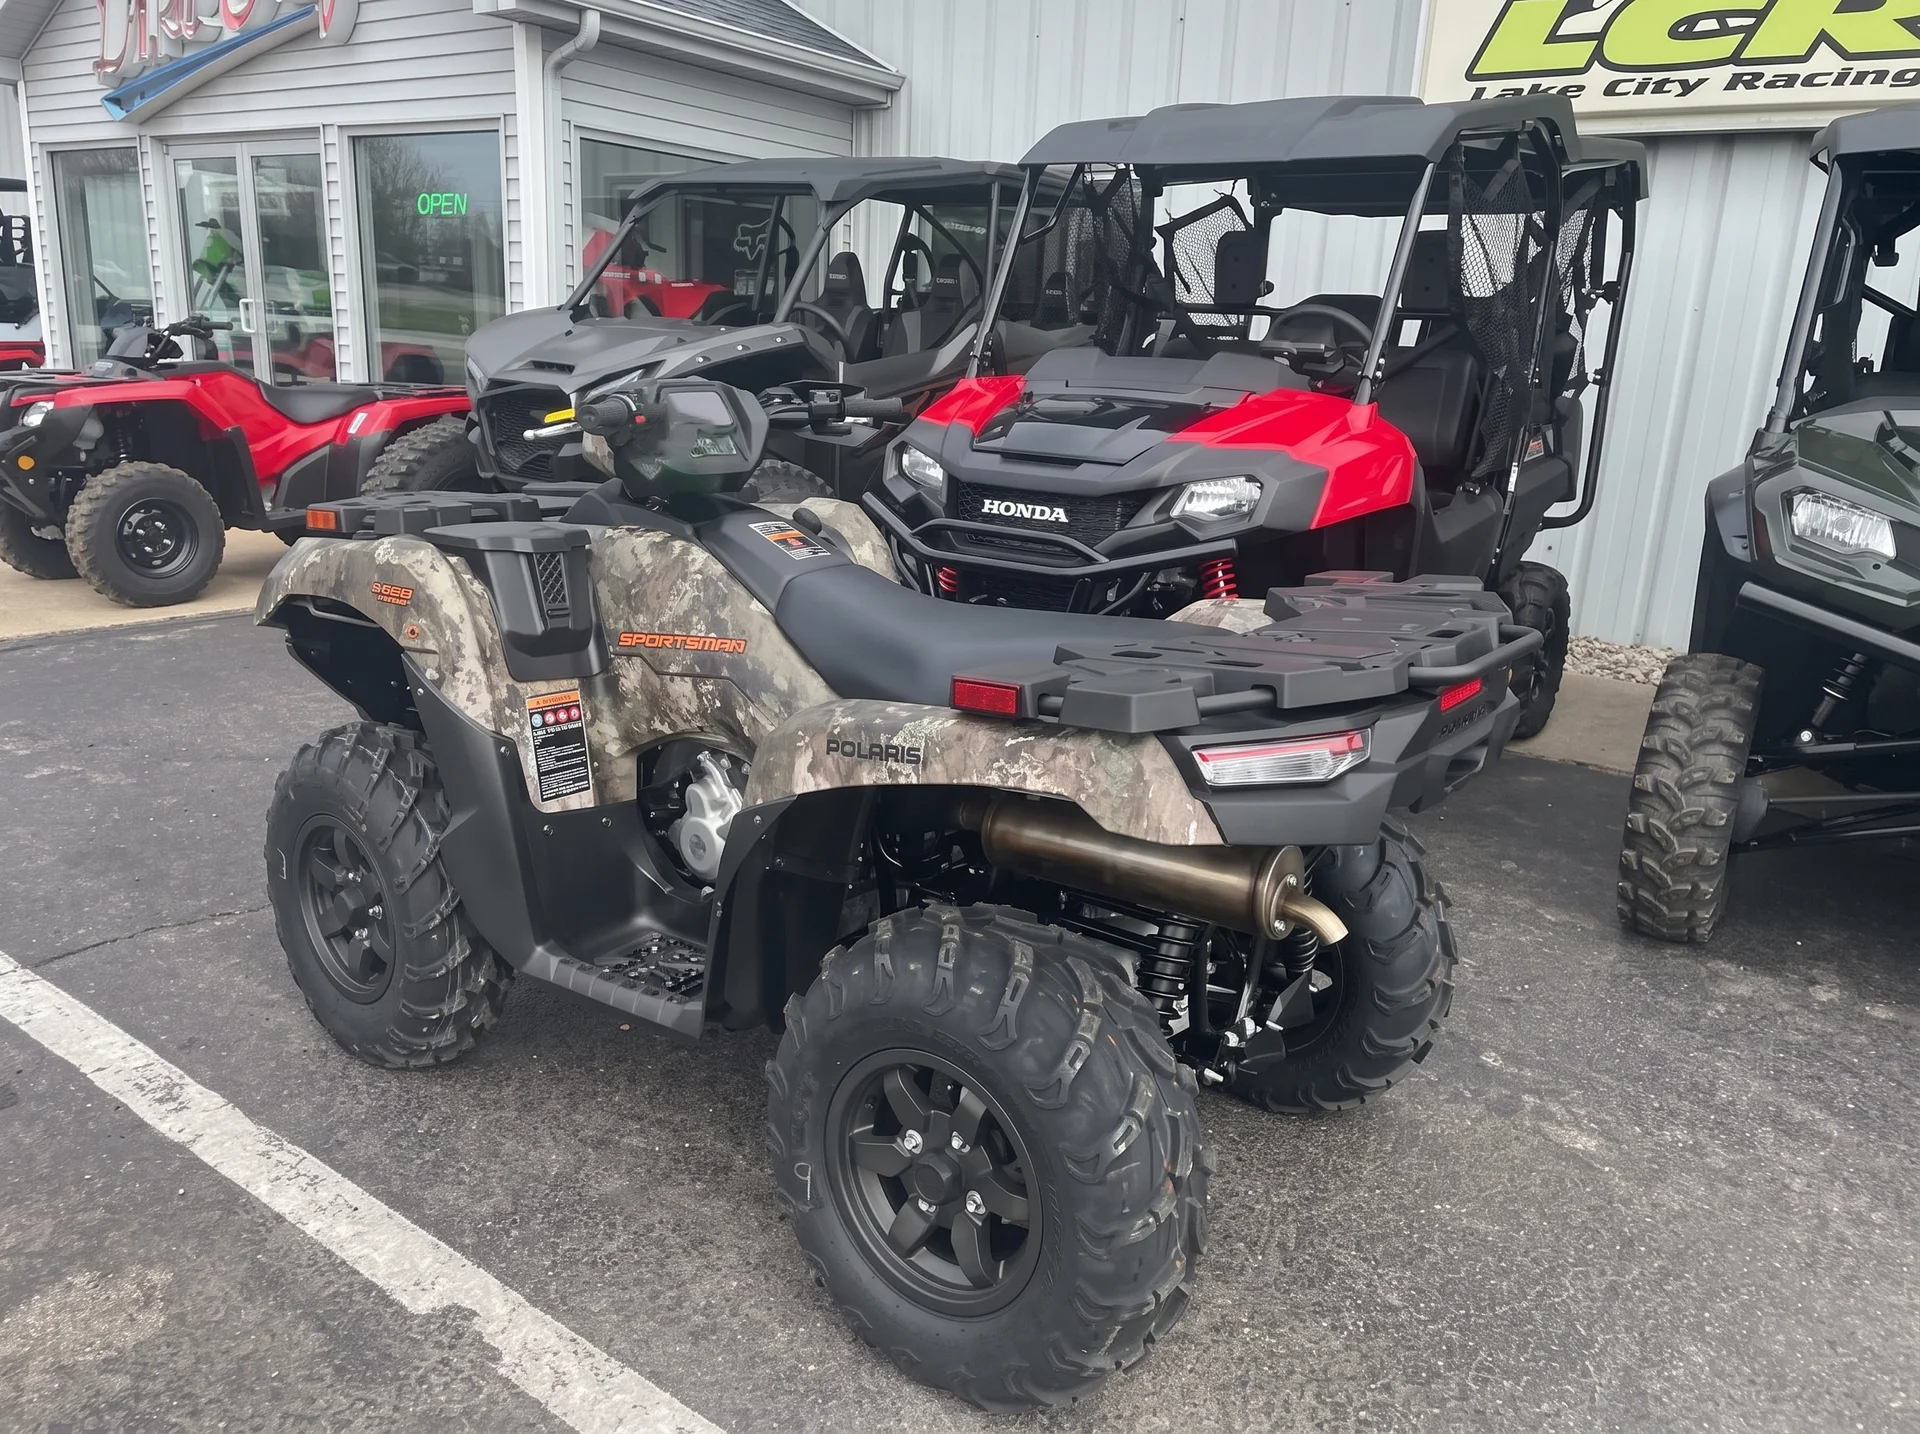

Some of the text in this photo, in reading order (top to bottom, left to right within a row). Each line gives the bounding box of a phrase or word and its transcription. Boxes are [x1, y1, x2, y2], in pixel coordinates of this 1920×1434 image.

[1602, 77, 1710, 98] City
[1723, 67, 1920, 92] Racing
[417, 192, 468, 216] OPEN
[981, 499, 1069, 523] HONDA
[618, 631, 748, 654] SPORTSMAN
[826, 738, 922, 765] POLARIS
